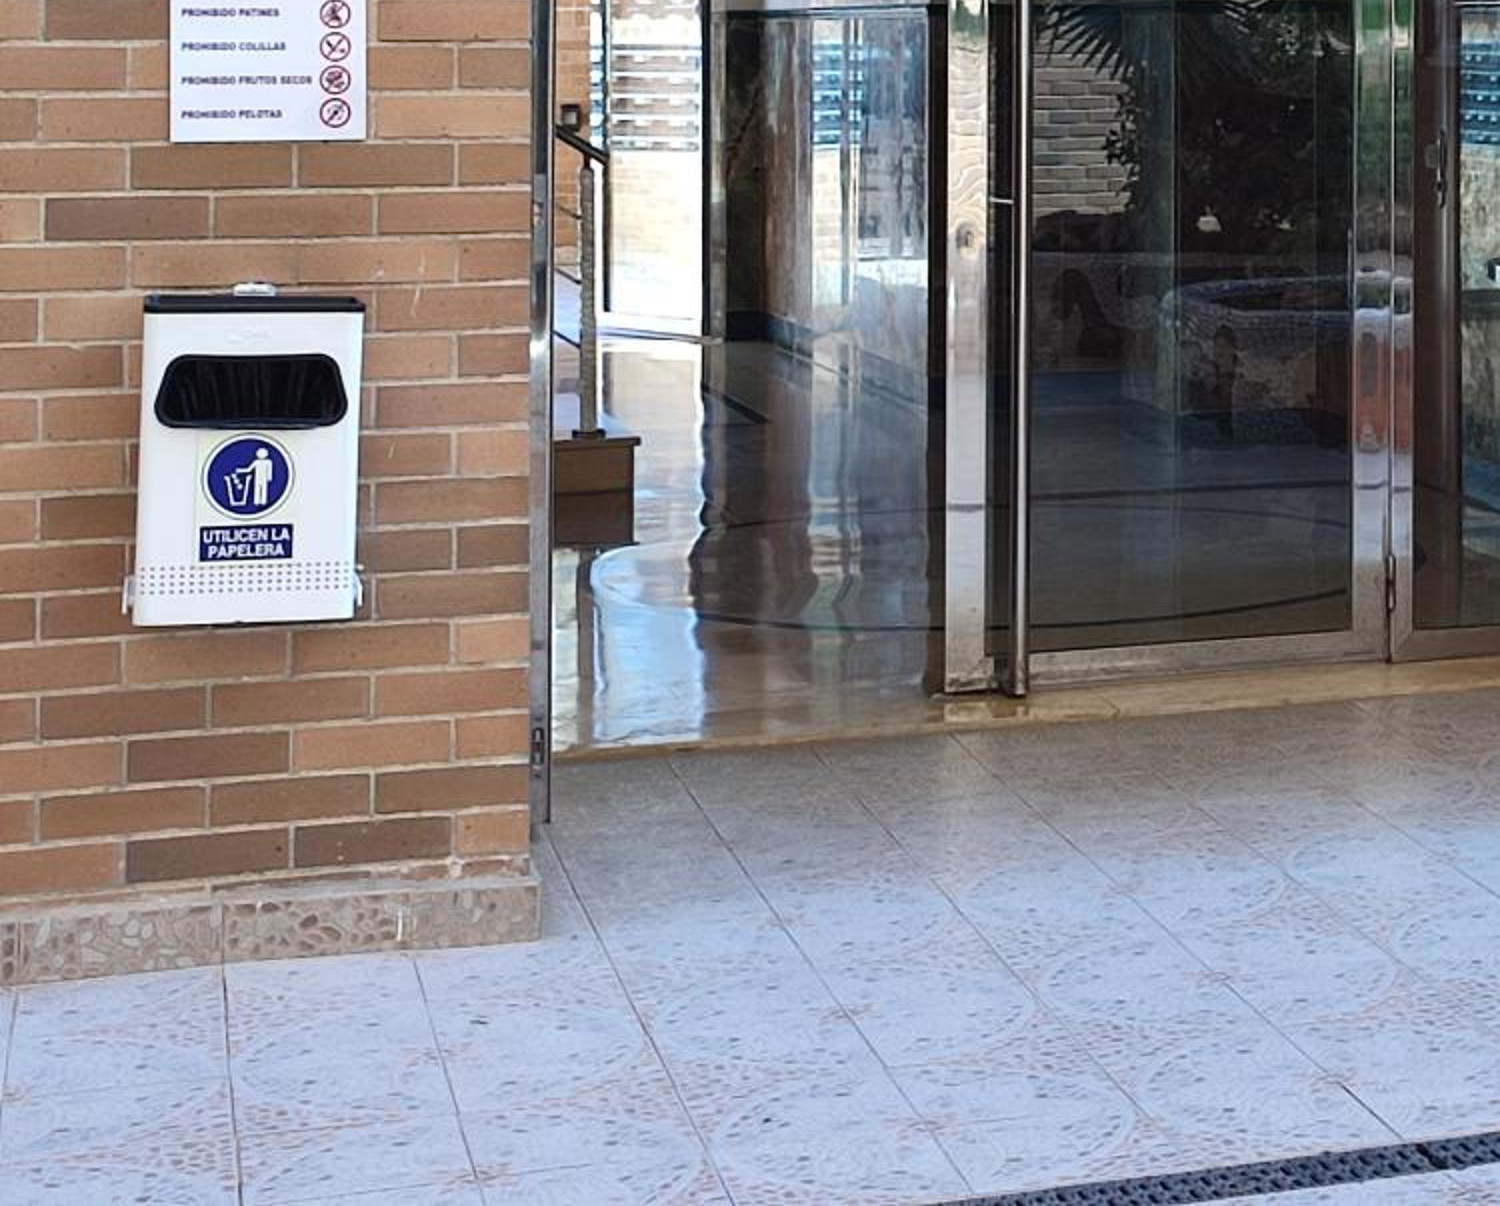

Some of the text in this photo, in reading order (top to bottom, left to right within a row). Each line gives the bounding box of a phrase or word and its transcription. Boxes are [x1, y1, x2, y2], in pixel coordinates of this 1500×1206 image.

[203, 527, 290, 544] UTILICEN LA
[207, 543, 285, 559] PAPELERA
